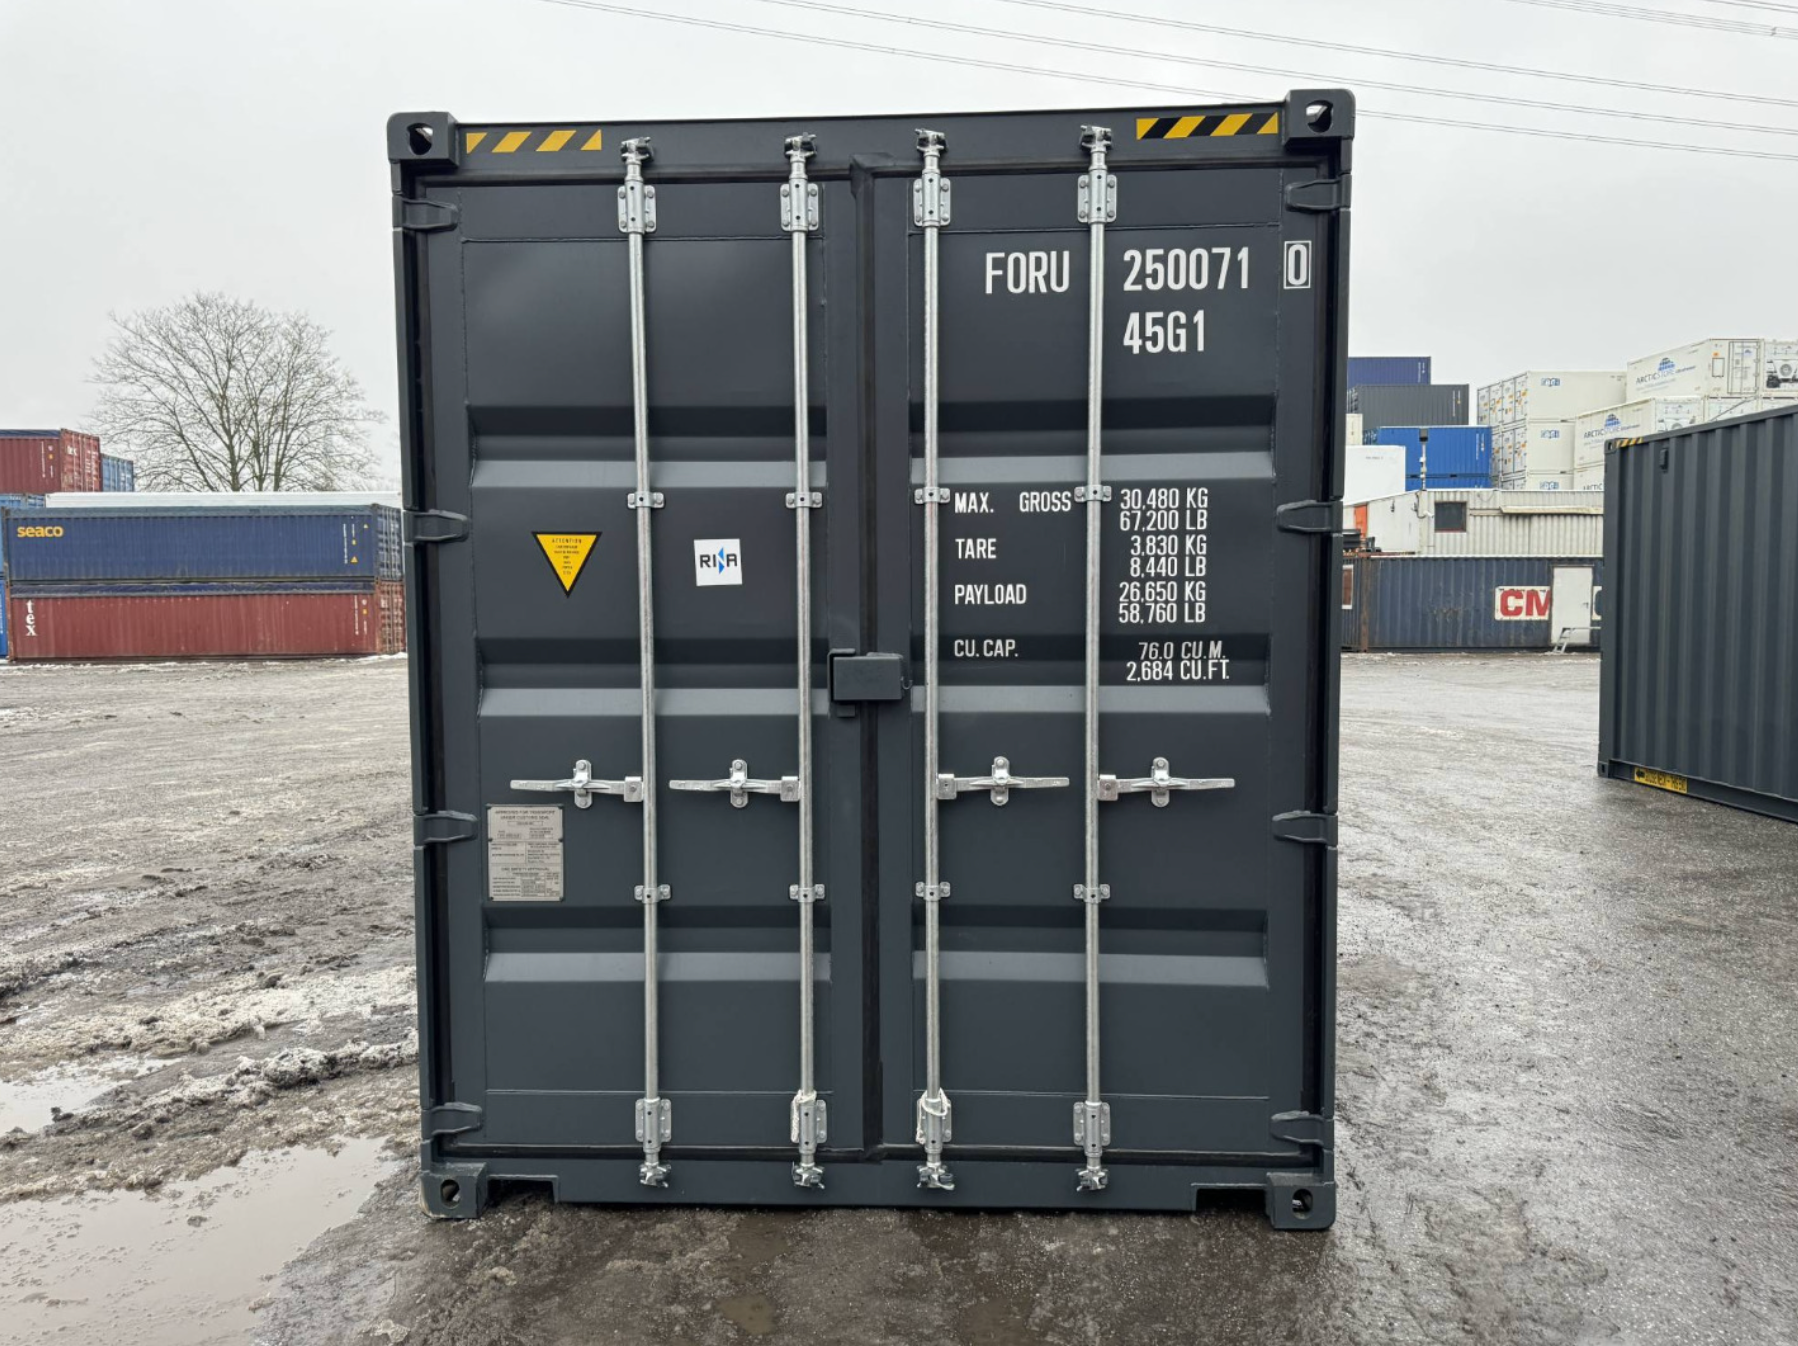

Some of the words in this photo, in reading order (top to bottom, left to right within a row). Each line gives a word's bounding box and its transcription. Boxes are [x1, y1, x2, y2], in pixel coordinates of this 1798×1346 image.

[985, 250, 1070, 294] FORU
[1123, 246, 1249, 292] 250071
[1287, 243, 1308, 286] 0
[1123, 309, 1205, 355] 45G1
[954, 492, 995, 514] MAX.
[1019, 491, 1072, 513] GROSS
[1120, 488, 1180, 512] 30,480
[1186, 487, 1209, 509] KG
[17, 526, 64, 538] seaco
[1119, 510, 1180, 533] 67,200
[1185, 509, 1208, 531] LB
[955, 538, 997, 560] TARE
[1130, 535, 1179, 556] 3,830
[1185, 534, 1207, 555] KG
[699, 548, 738, 573] RINA
[1129, 557, 1178, 579] 8,440
[1184, 556, 1207, 577] LB
[954, 584, 1027, 605] PAYLOAD
[1119, 582, 1178, 604] 26,650
[1185, 581, 1207, 603] KG
[25, 599, 38, 636] tex
[1118, 603, 1178, 625] 58,760
[1184, 602, 1206, 623] LB
[1138, 641, 1174, 660] 76.0
[1126, 660, 1173, 682] 2,684
